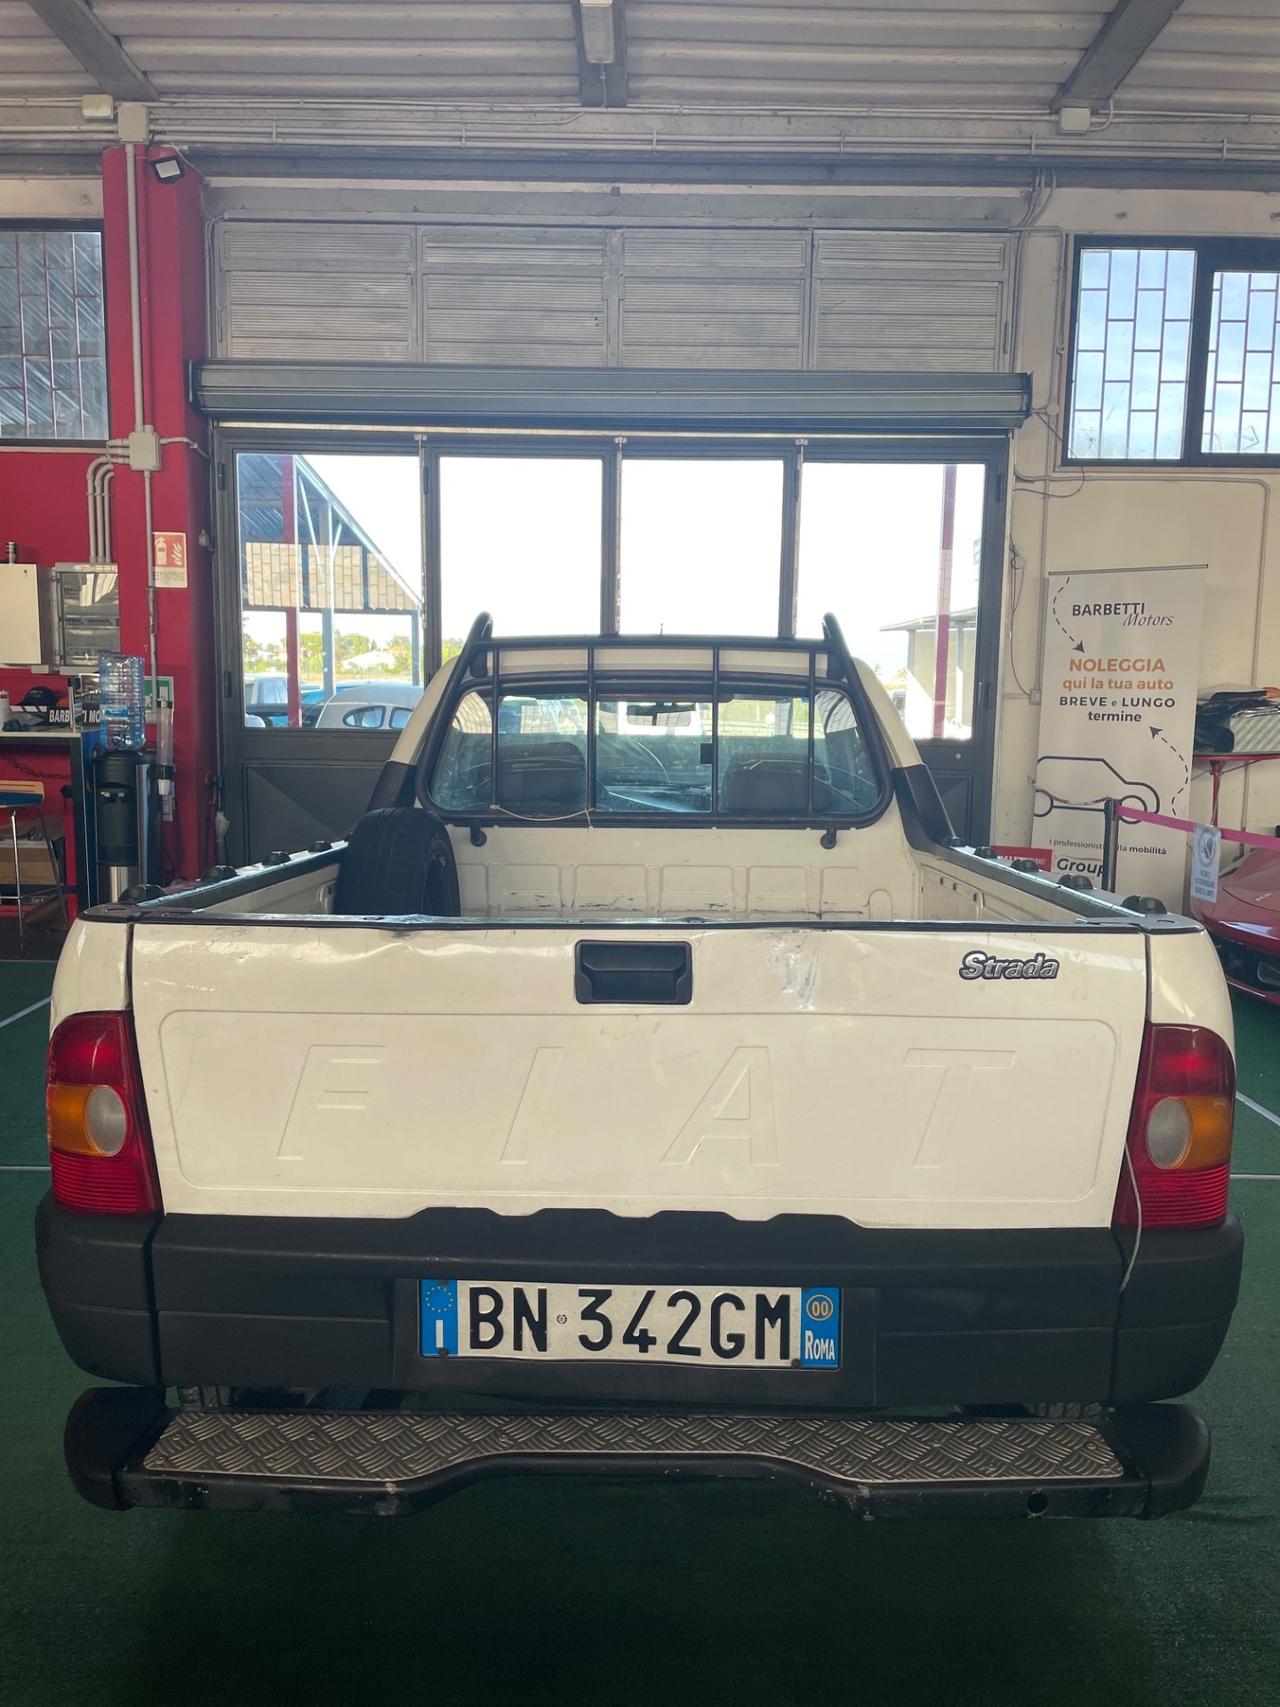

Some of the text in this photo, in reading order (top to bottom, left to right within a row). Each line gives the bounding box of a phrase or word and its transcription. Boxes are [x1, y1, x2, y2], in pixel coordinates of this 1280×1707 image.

[1072, 602, 1145, 616] BARBETTI
[1122, 612, 1175, 627] Motors
[1069, 658, 1166, 672] NOLEGGIA
[1062, 677, 1174, 692] qui la tua auto
[1059, 696, 1108, 707] BREVE
[1122, 697, 1176, 708] LUNGO
[1088, 711, 1142, 722] termine
[1129, 846, 1167, 855] mobilità
[959, 949, 1060, 980] Strada
[276, 1044, 1017, 1168] FIAT
[469, 1286, 791, 1360] BN 342GM
